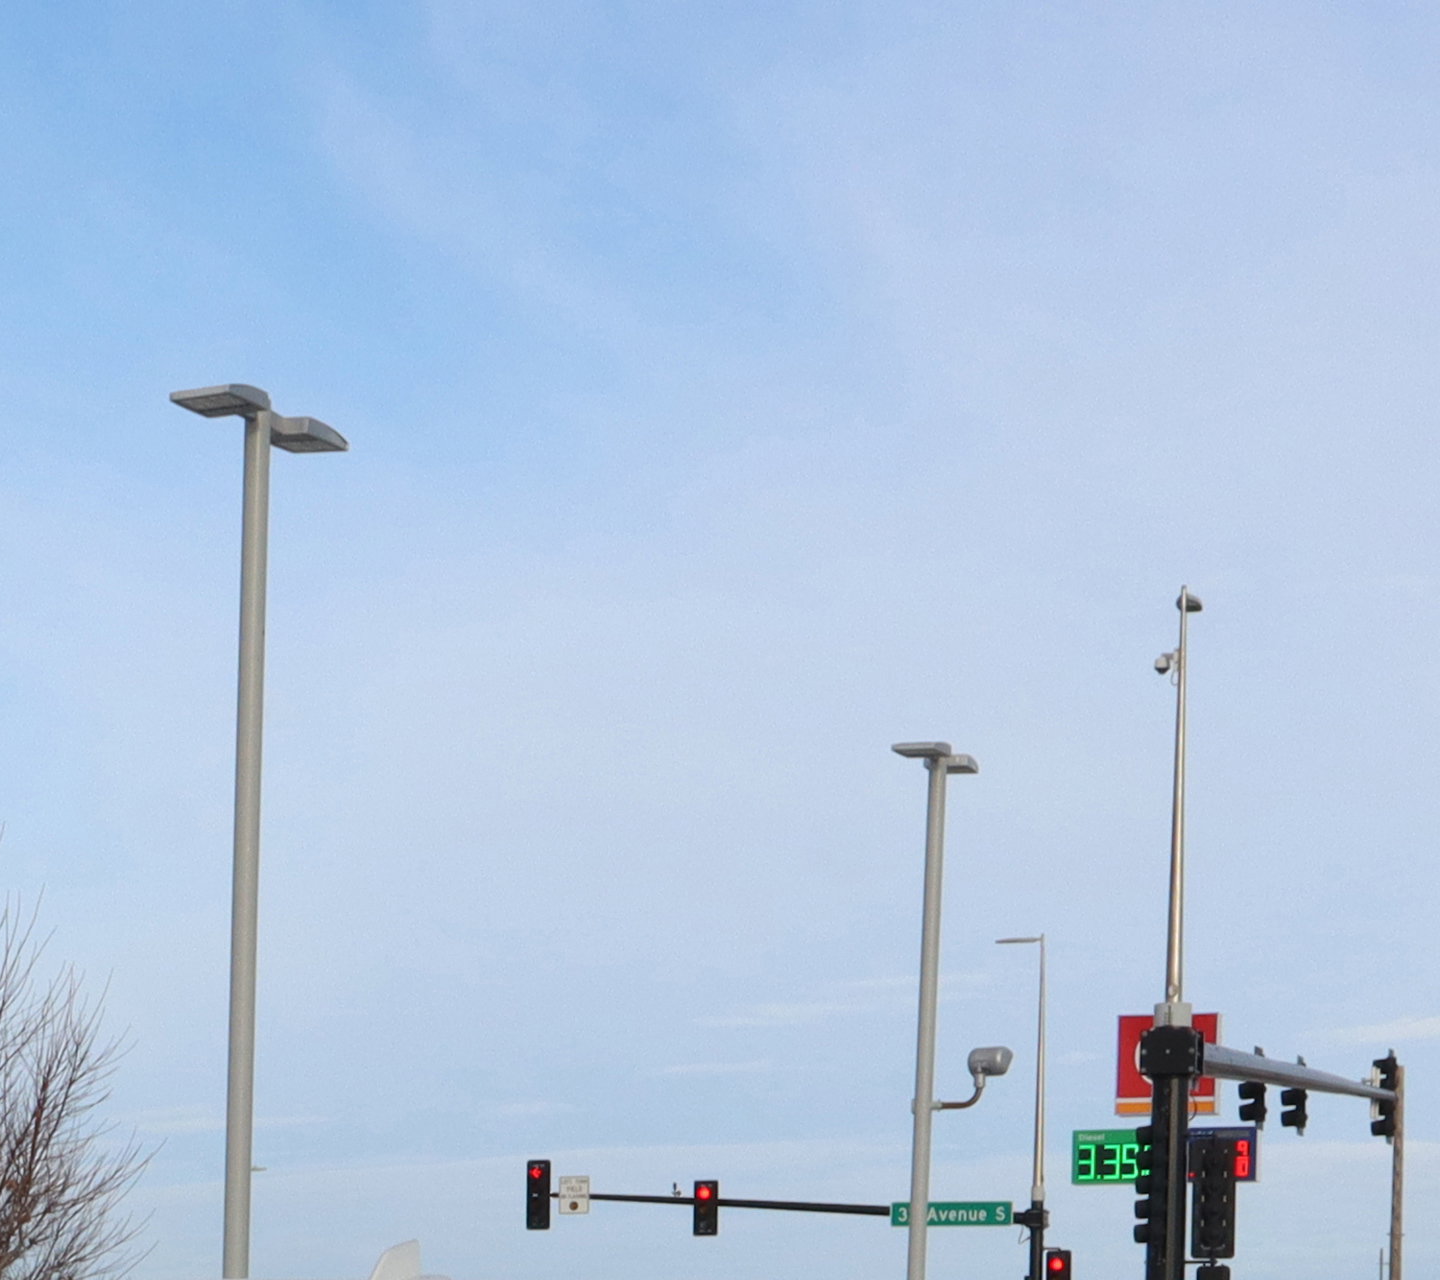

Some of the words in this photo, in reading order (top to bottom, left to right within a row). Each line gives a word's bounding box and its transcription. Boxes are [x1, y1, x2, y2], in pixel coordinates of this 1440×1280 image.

[1077, 1133, 1105, 1142] Diesel
[1077, 1144, 1151, 1180] 3.35
[927, 1206, 987, 1222] Avenue
[995, 1206, 1006, 1221] S
